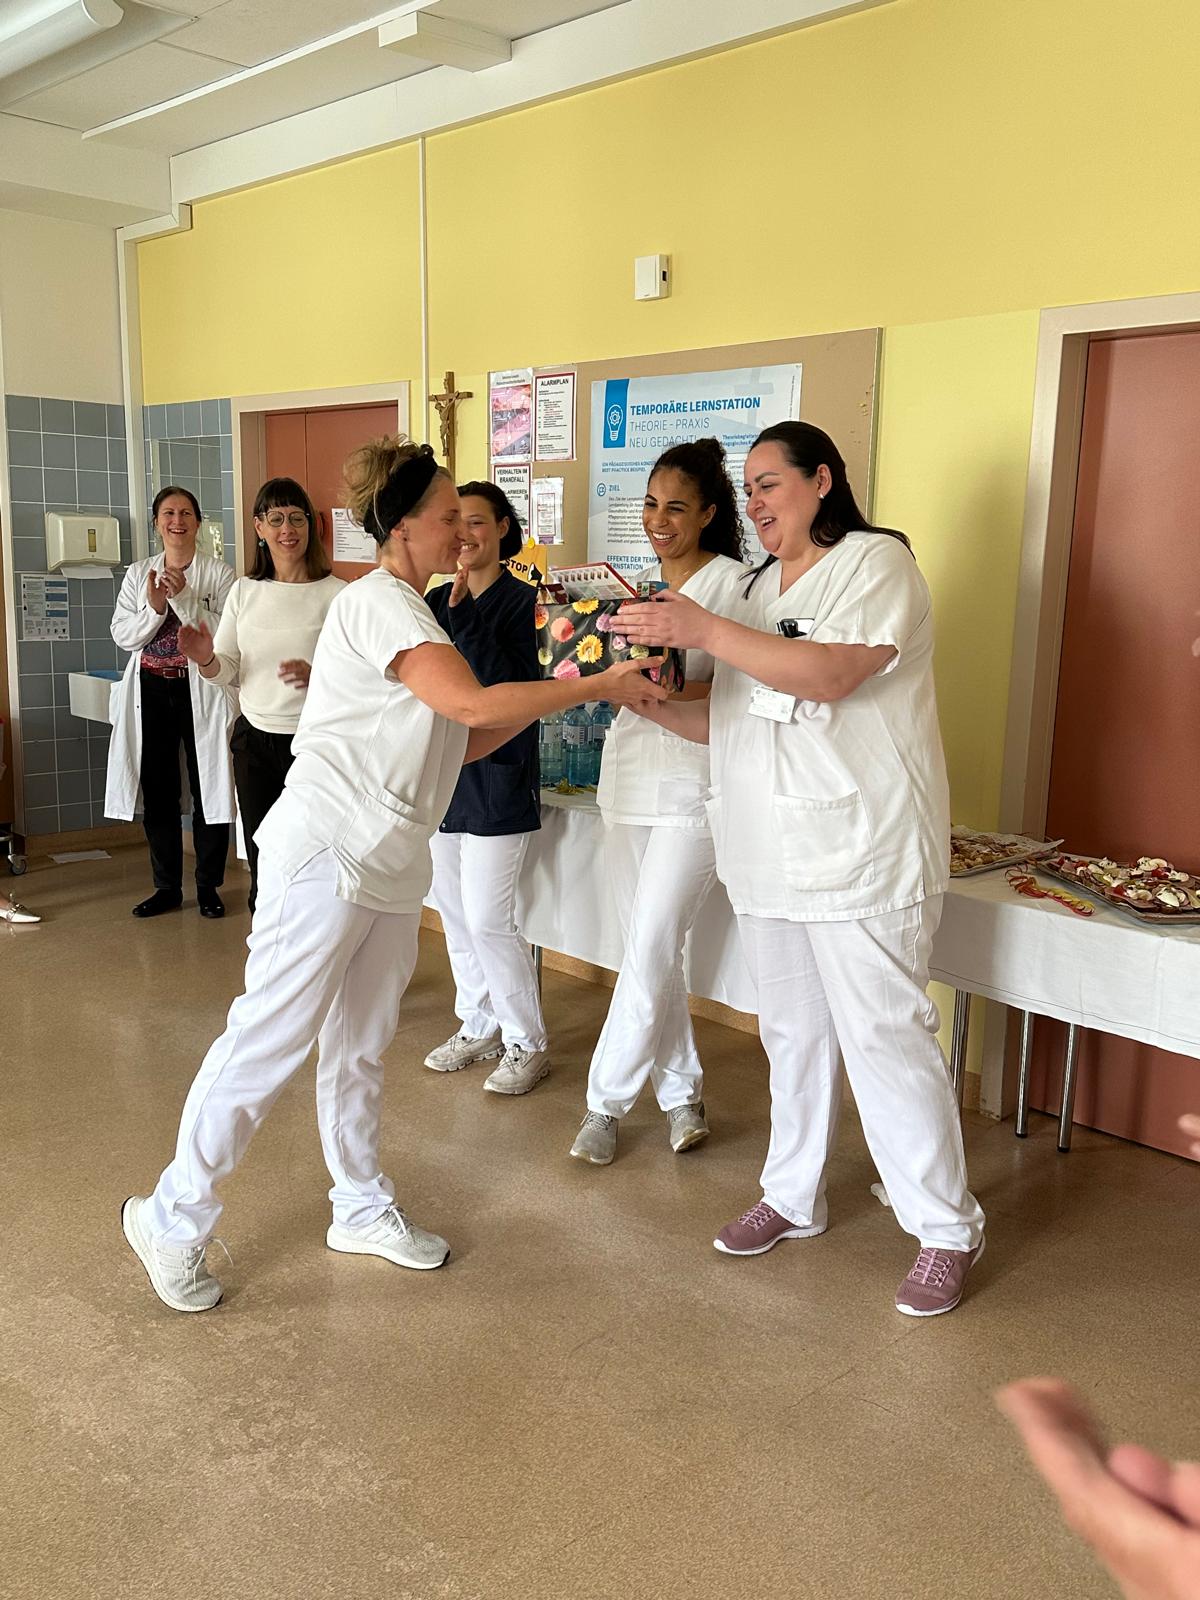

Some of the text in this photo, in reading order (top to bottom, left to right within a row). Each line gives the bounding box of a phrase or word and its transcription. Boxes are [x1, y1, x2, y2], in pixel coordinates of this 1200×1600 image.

[541, 378, 569, 386] ALARMPLAN
[630, 396, 761, 416] TEMPORÄRE LERNSTATION
[630, 420, 667, 432] THEORIE
[675, 417, 710, 430] PRAXIS
[629, 437, 647, 448] NEU
[505, 558, 528, 573] STOP
